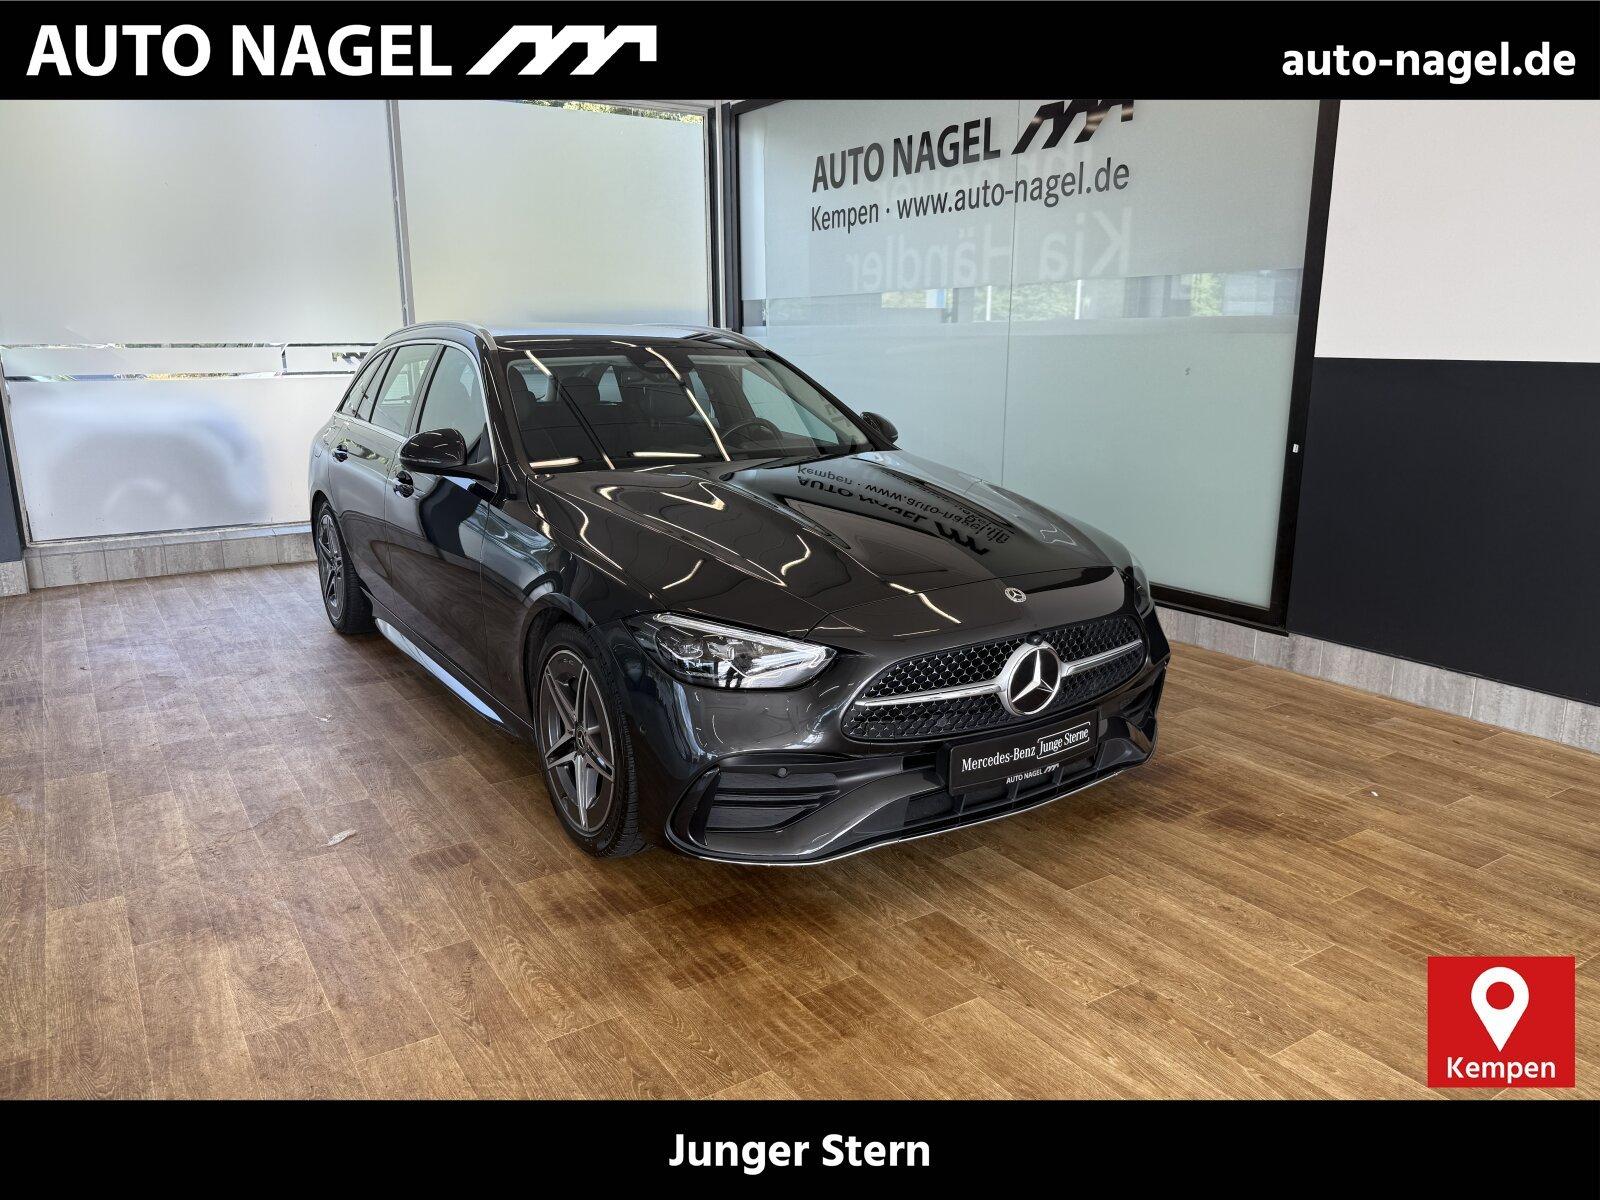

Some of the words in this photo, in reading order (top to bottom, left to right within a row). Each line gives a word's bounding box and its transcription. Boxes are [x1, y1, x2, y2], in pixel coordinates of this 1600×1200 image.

[812, 142, 885, 193] AUTO
[892, 117, 1001, 178] NAGEL
[811, 203, 879, 233] Kempen
[897, 156, 1130, 219] www.auto-nagel.de
[961, 746, 1036, 773] Mercedes-Benz
[1039, 738, 1063, 756] Junge
[1063, 728, 1089, 746] Sterne
[1005, 773, 1024, 785] AUTO
[1024, 769, 1043, 780] NAGEL
